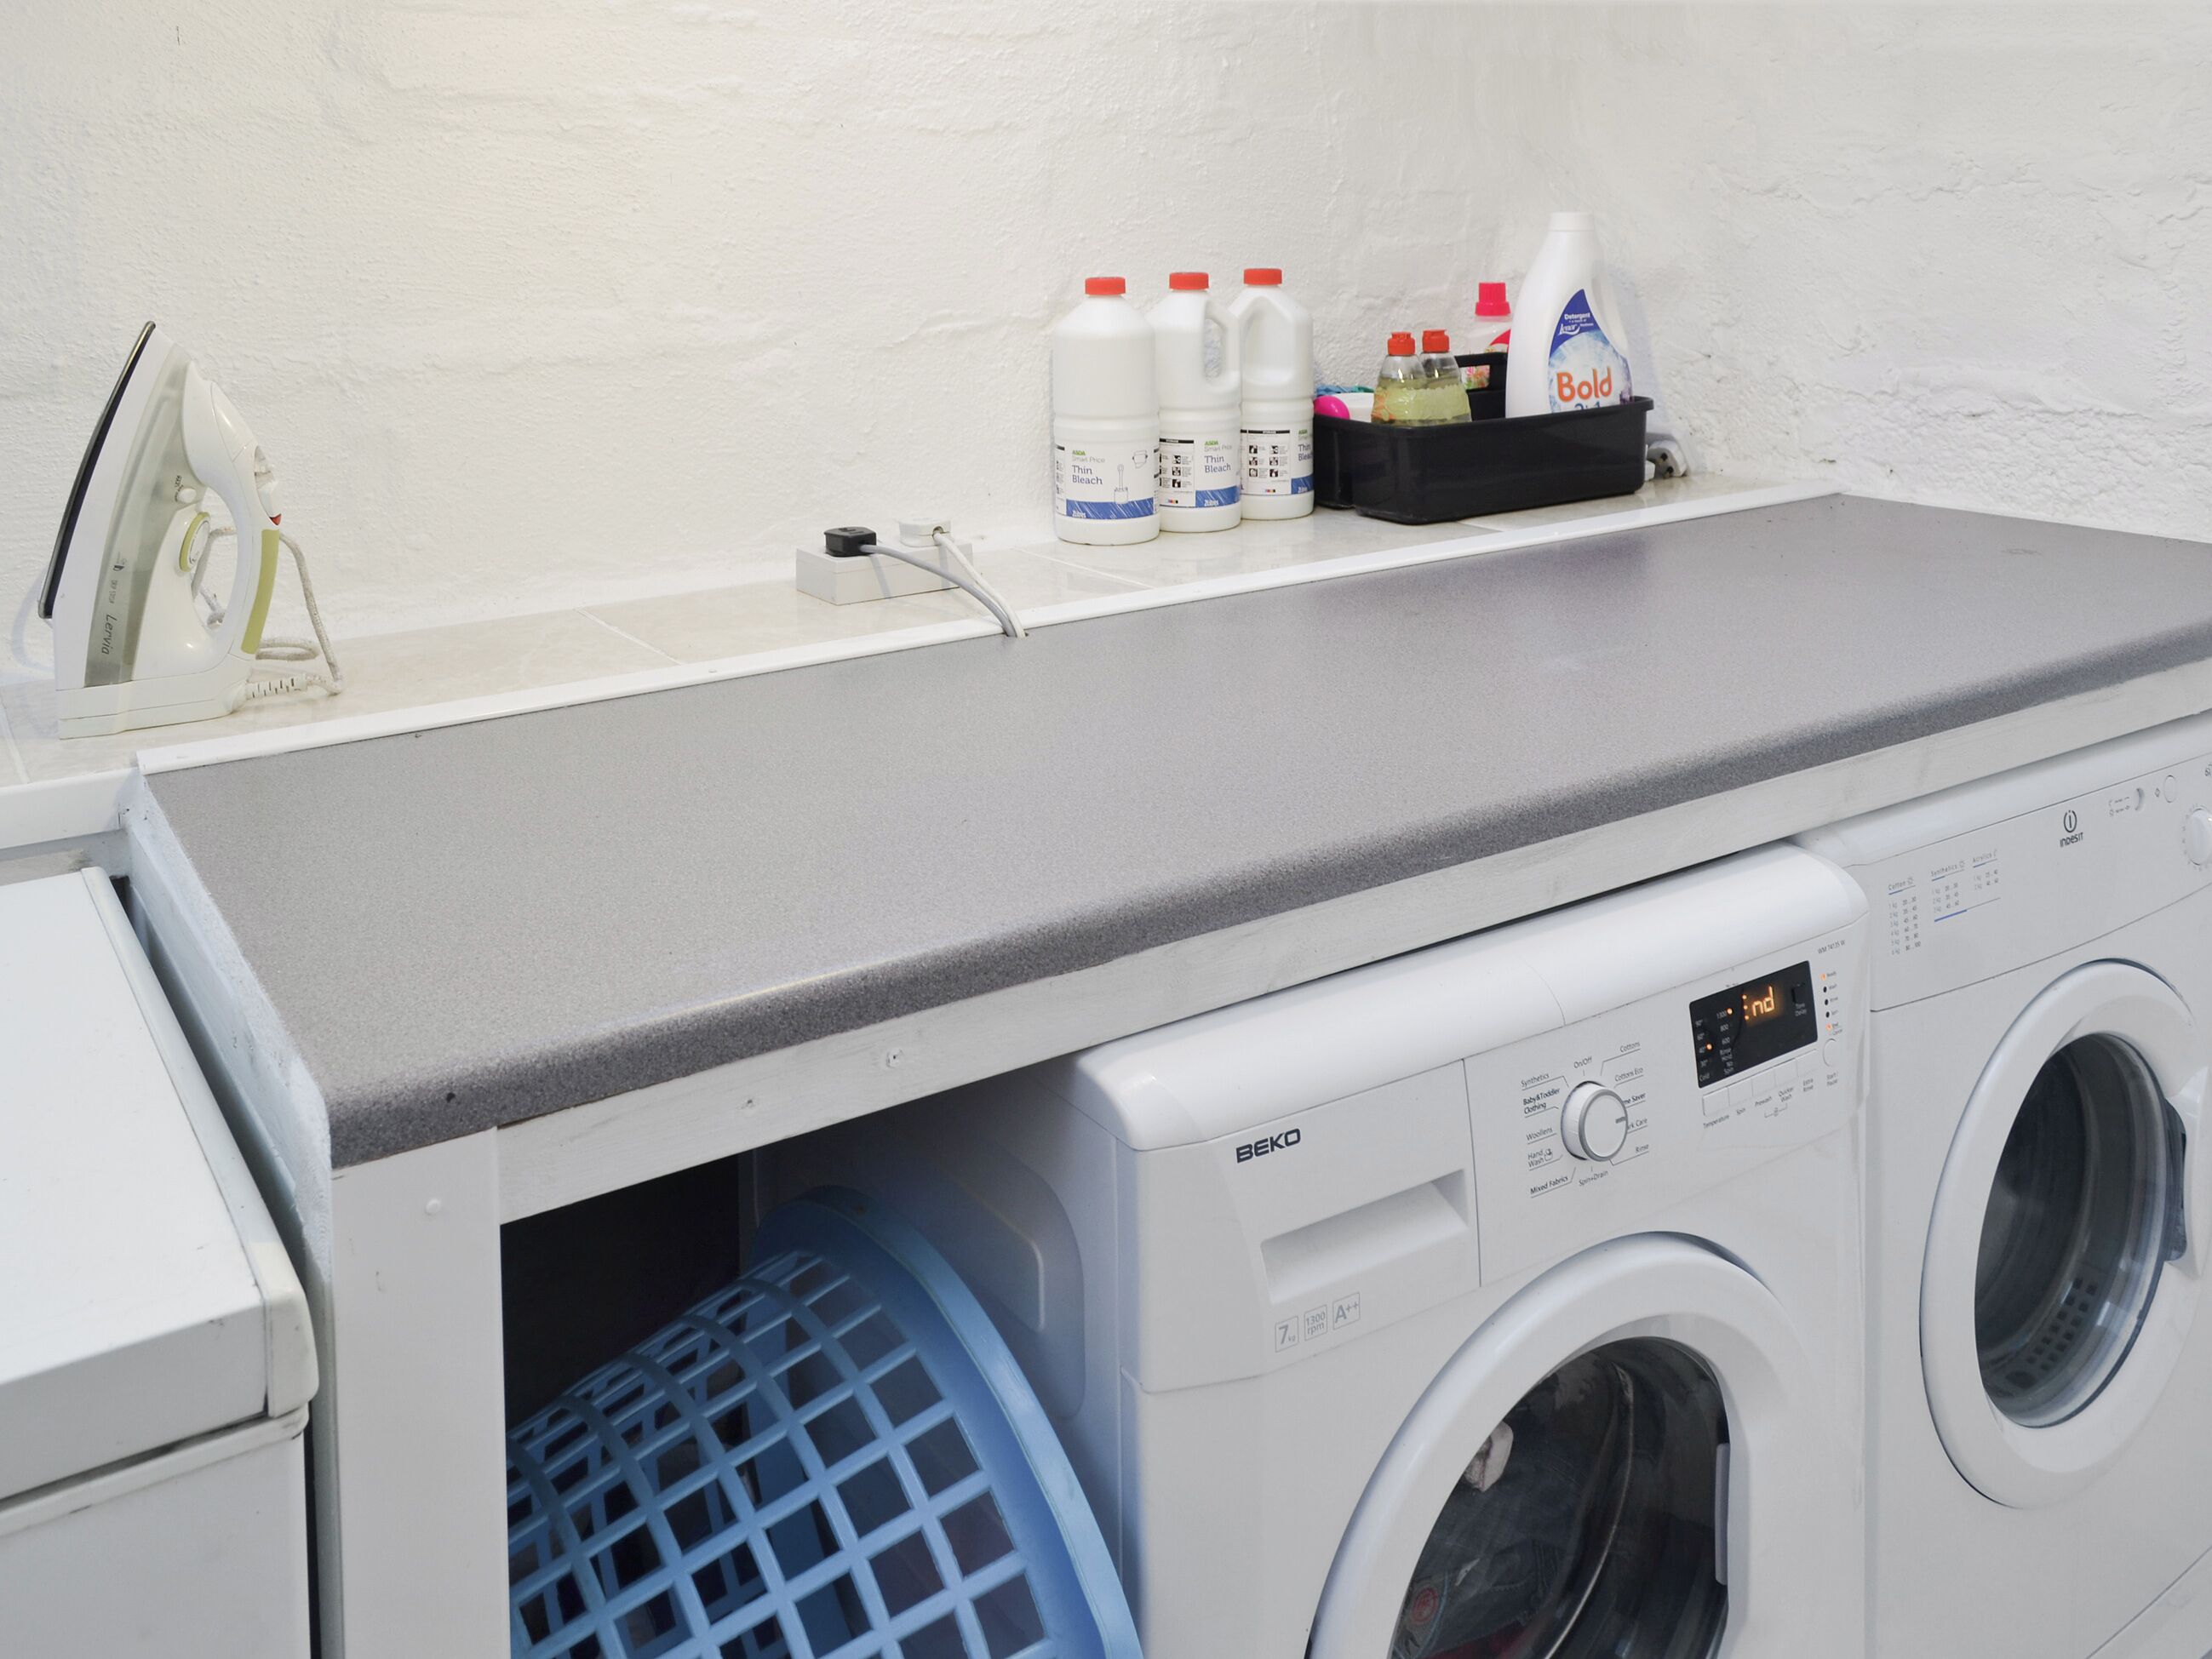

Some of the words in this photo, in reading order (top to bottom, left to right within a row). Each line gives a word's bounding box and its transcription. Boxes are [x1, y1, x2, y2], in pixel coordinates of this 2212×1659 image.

[1564, 312, 1590, 321] Detergent
[1556, 366, 1613, 403] Bold
[1204, 455, 1224, 463] Thin
[1072, 465, 1092, 475] Thin
[1205, 463, 1231, 473] Bleach
[1072, 475, 1103, 485] Bleach
[1888, 881, 1905, 891] Cotton
[1619, 1041, 1640, 1053] Cottons
[1573, 1055, 1592, 1069] On/Off
[1521, 1073, 1550, 1088] Synthetics
[1614, 1071, 1633, 1082] Cottons
[1634, 1067, 1643, 1076] Eco
[1522, 1088, 1560, 1106] Baby&Toddler
[1631, 1092, 1646, 1102] Saver
[1524, 1102, 1547, 1115] Clothing
[1636, 1118, 1648, 1127] Care
[1526, 1127, 1553, 1141] Woollens
[1235, 1128, 1301, 1164] BEKO
[1635, 1143, 1649, 1153] Rinse
[1527, 1151, 1544, 1160] Hand
[1528, 1157, 1544, 1168] Wash
[1579, 1170, 1608, 1187] Spin+Drain
[1530, 1181, 1548, 1195] Mixed
[1549, 1176, 1568, 1188] Fabrics
[1306, 1311, 1327, 1328] 1300
[1307, 1322, 1325, 1336] rpm
